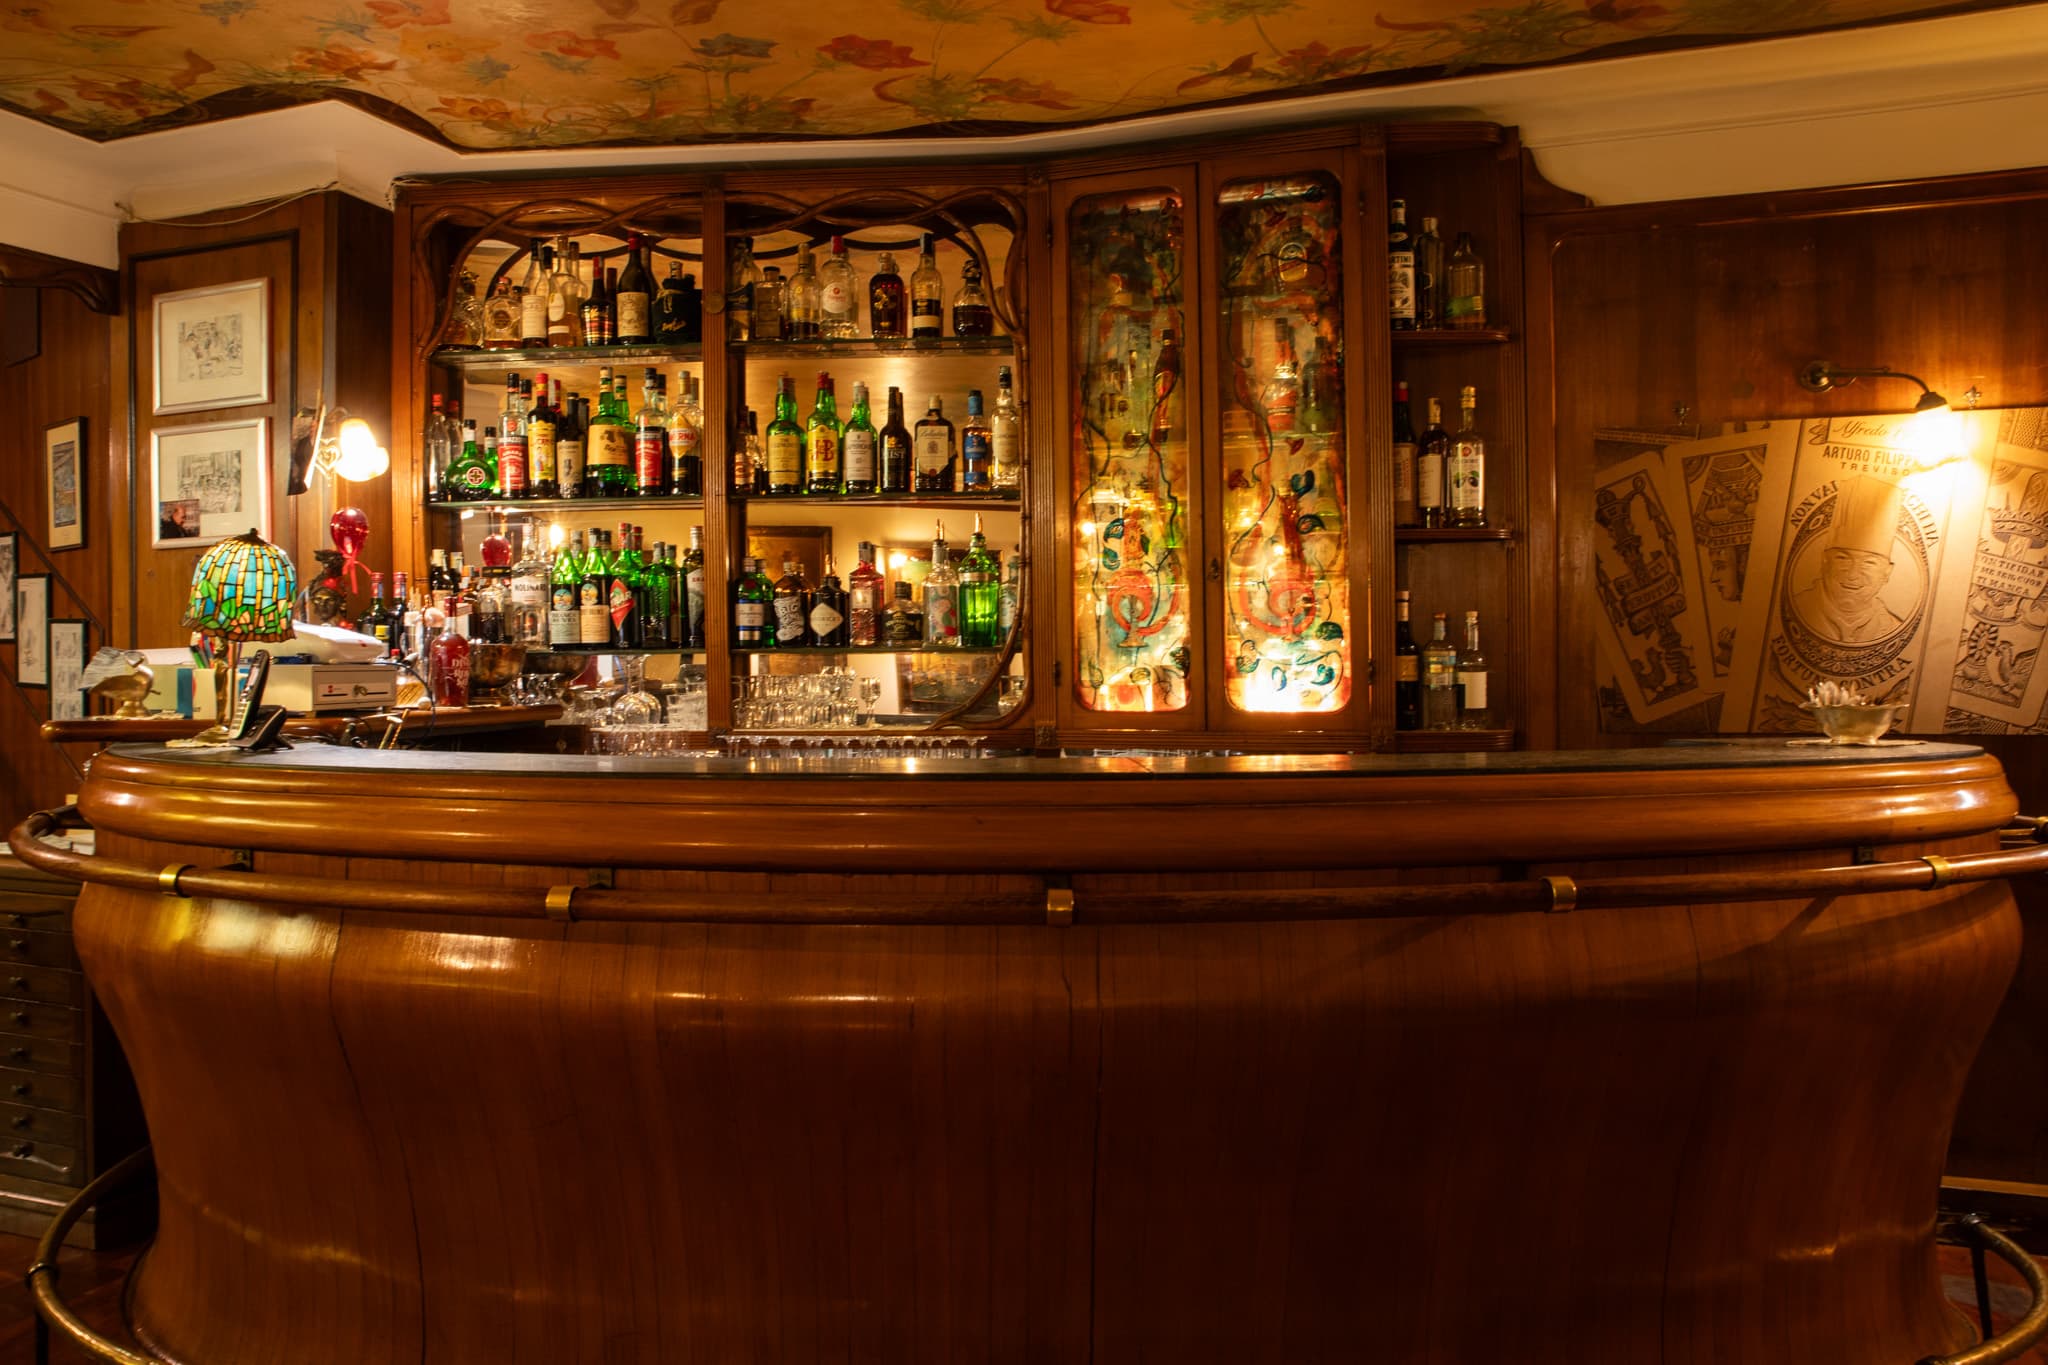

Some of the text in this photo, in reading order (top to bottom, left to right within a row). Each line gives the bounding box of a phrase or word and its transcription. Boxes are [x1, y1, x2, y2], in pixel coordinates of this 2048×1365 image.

[1832, 421, 1889, 438] Alfredo
[1823, 445, 1914, 467] ARTURO FILIPP
[1841, 462, 1913, 478] TREVISO
[1790, 498, 1816, 531] NON
[1772, 634, 1826, 687] FORTUN
